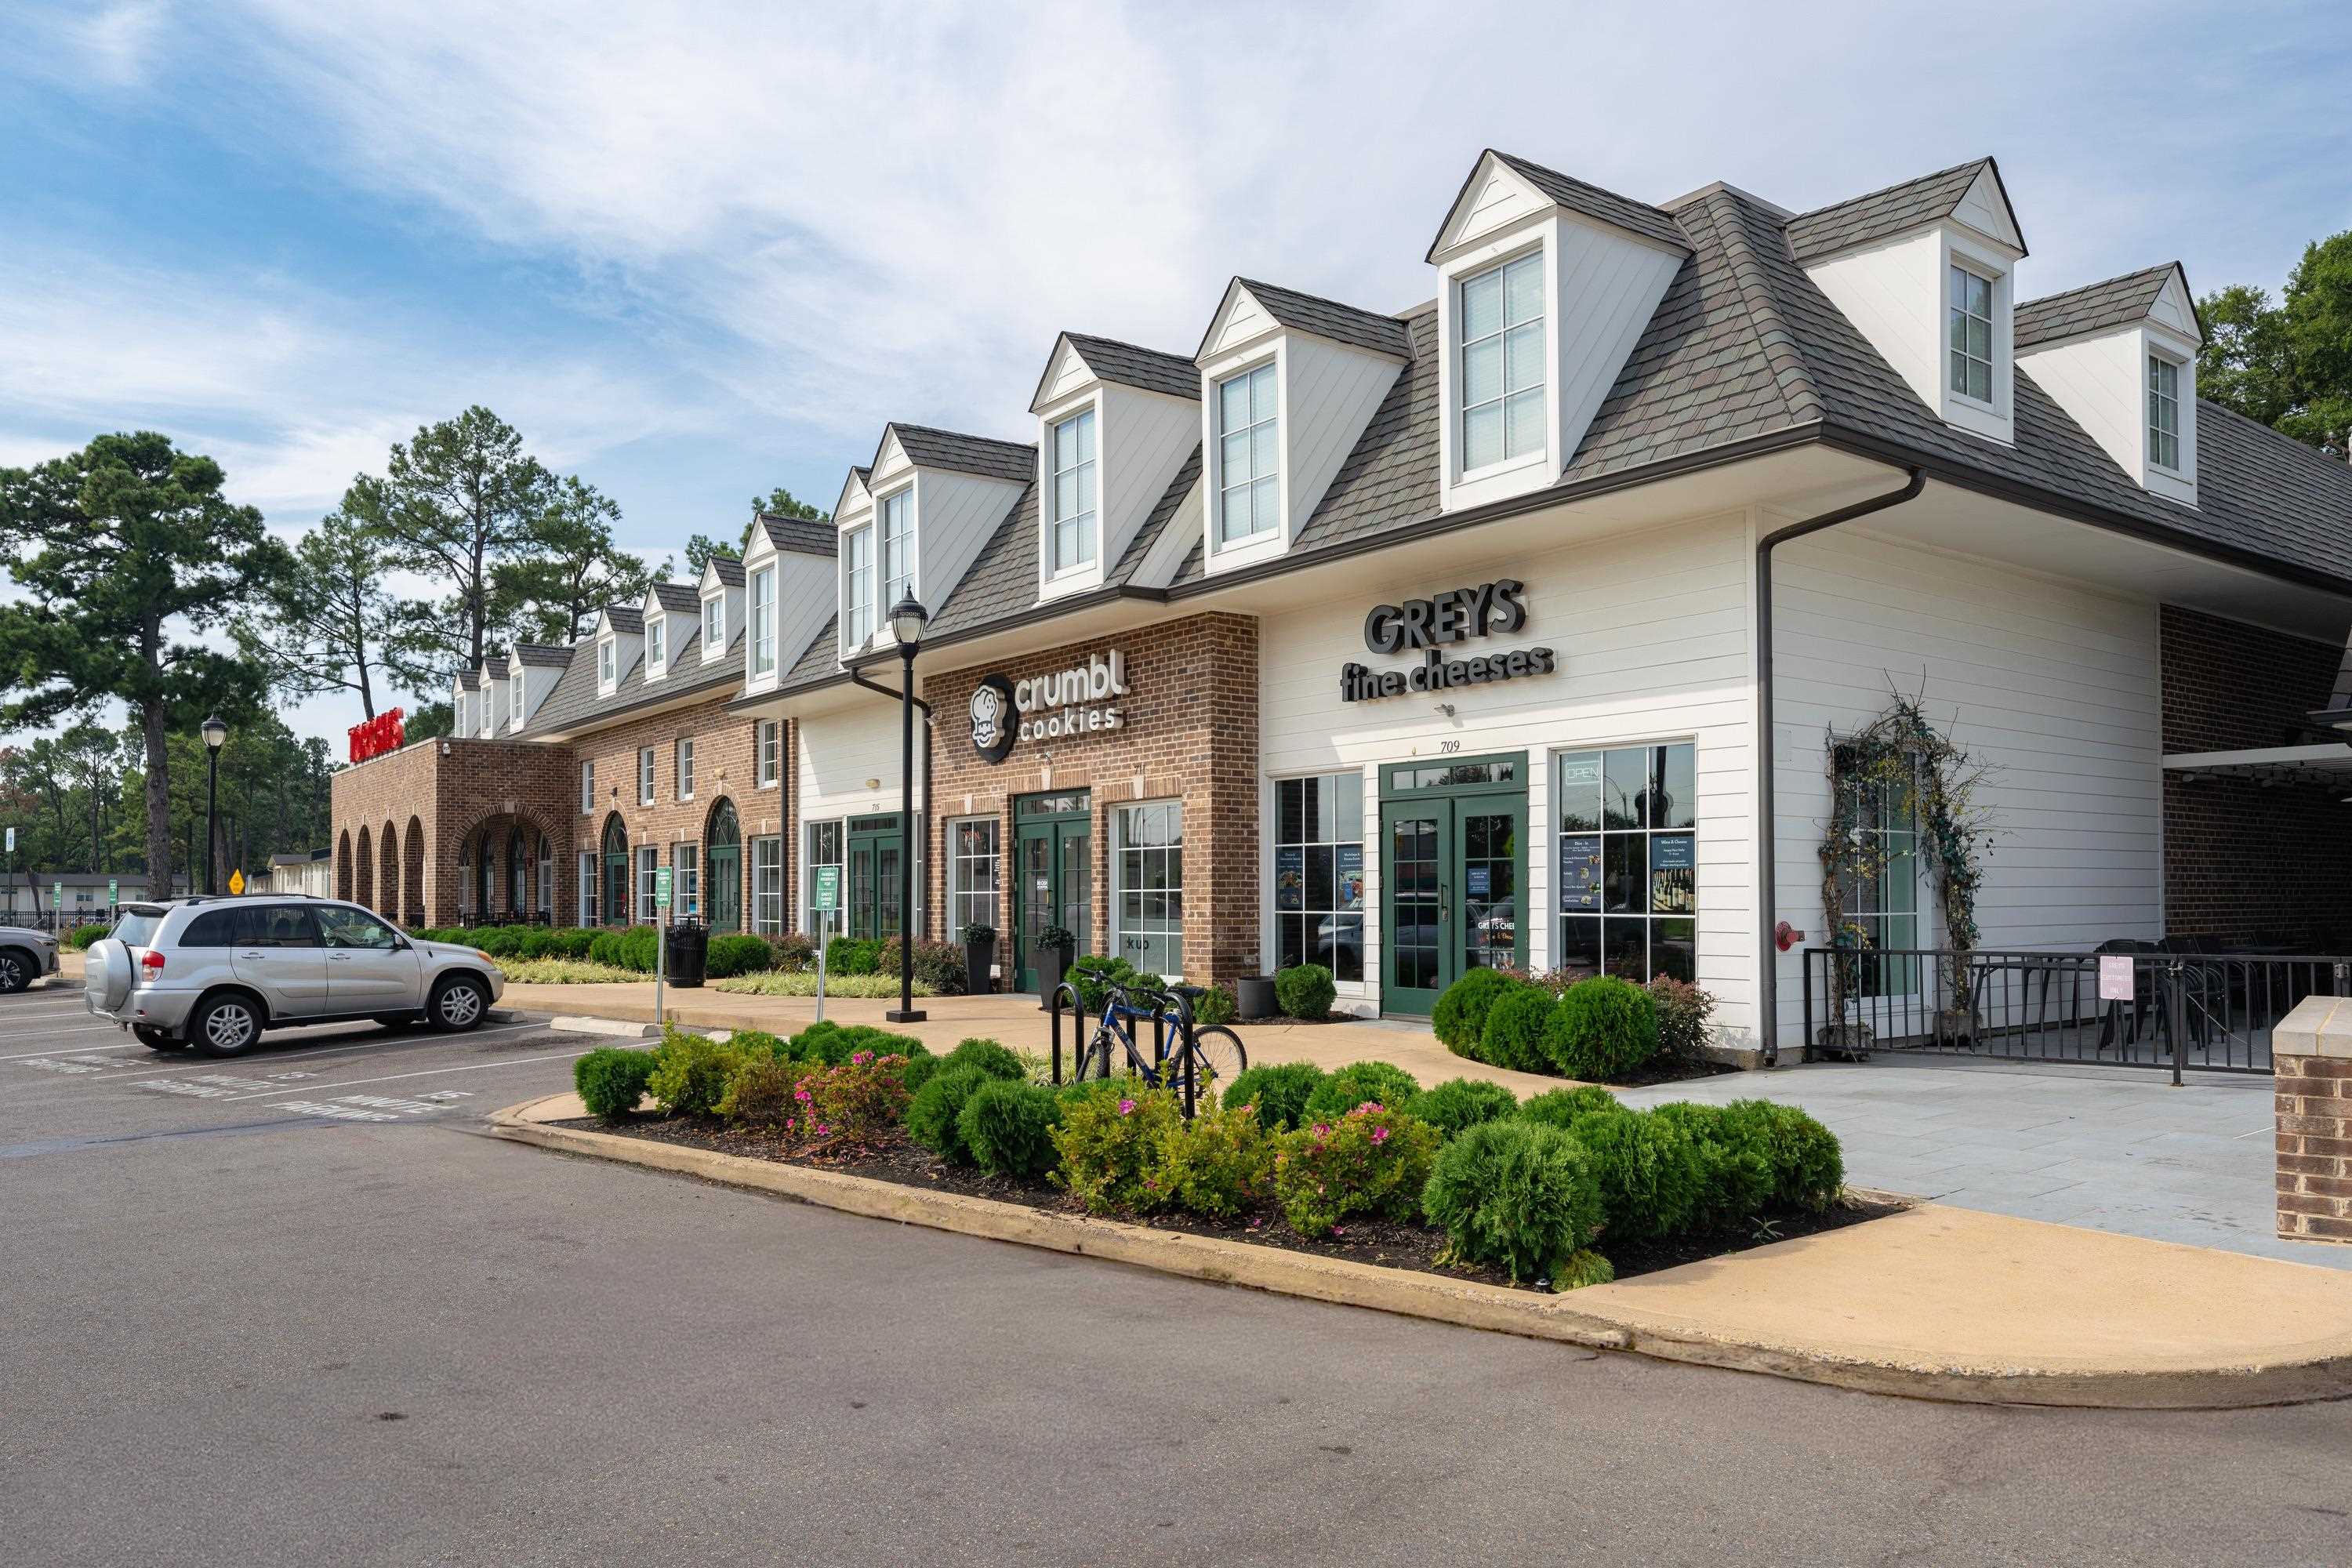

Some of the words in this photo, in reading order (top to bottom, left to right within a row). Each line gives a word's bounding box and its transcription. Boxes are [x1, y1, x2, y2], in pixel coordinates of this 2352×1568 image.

[1365, 579, 1526, 654] GREYS
[1014, 648, 1127, 712] crumbl
[1341, 663, 1407, 702] fine
[1410, 647, 1555, 692] cheeses
[1020, 706, 1120, 741] cookies
[1441, 740, 1459, 753] 709
[1568, 768, 1599, 779] OPEN
